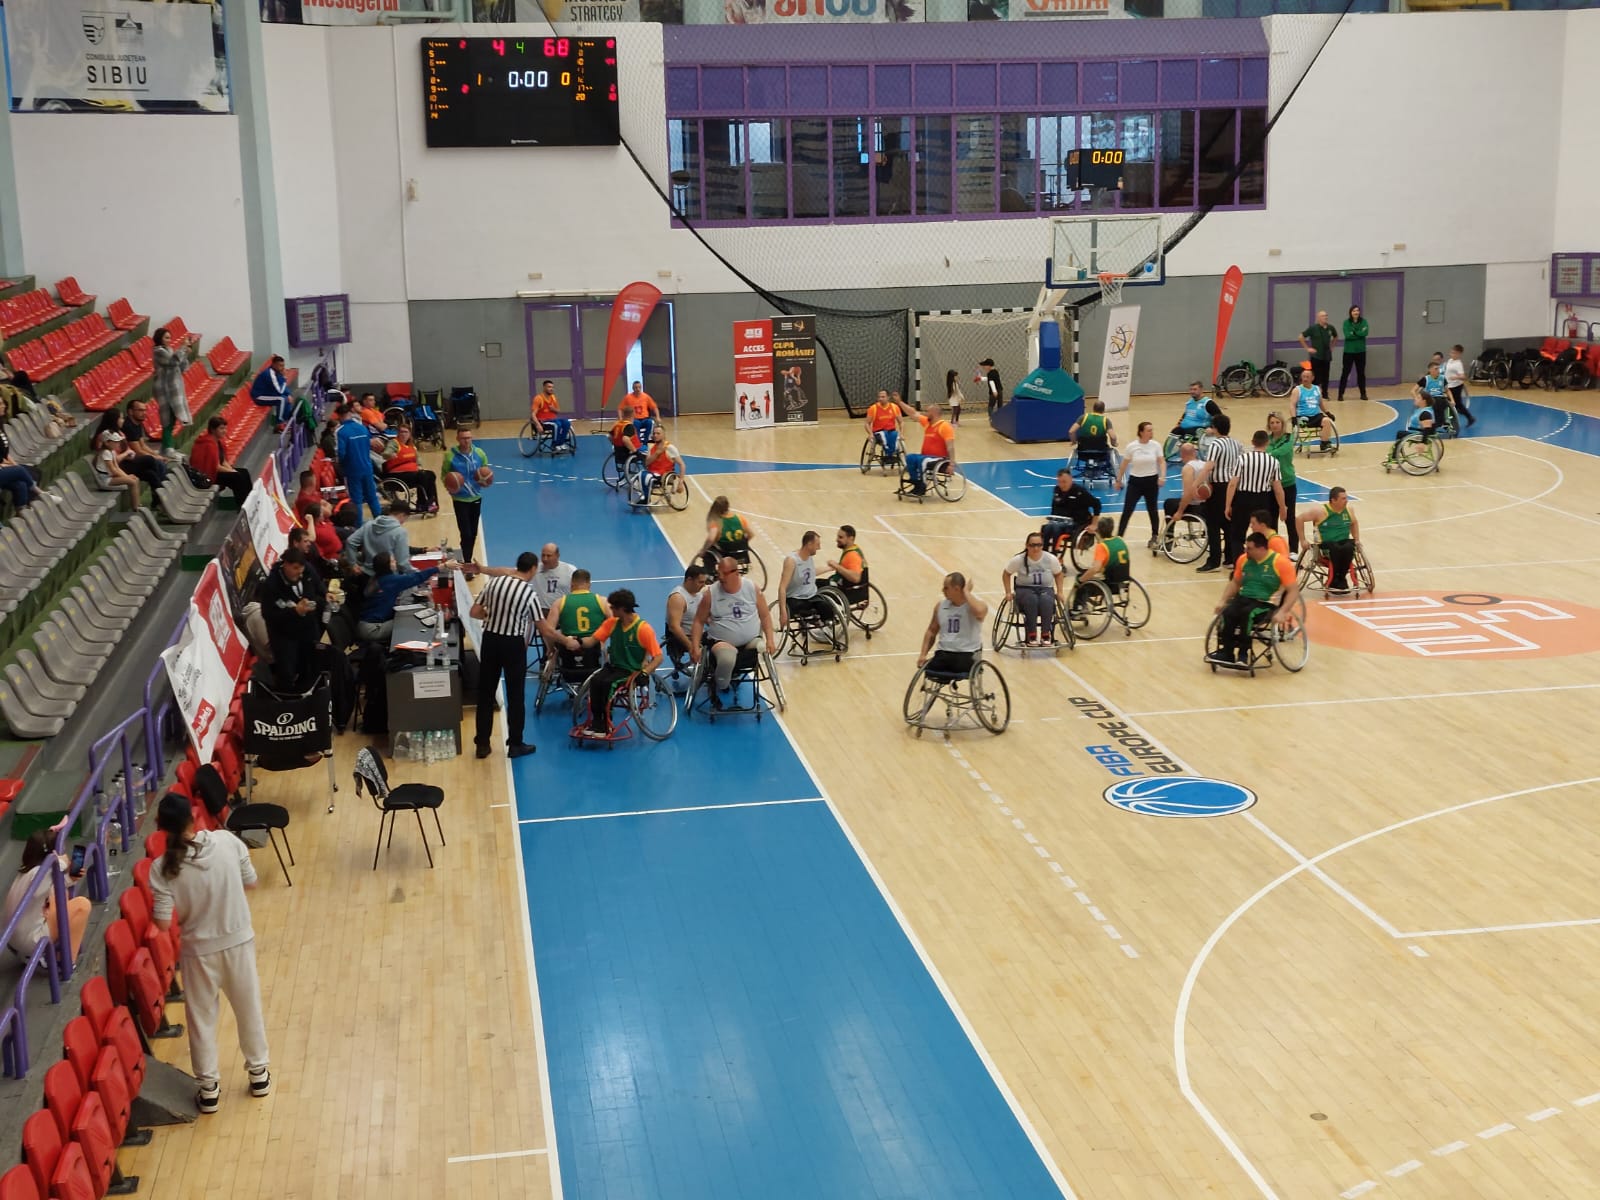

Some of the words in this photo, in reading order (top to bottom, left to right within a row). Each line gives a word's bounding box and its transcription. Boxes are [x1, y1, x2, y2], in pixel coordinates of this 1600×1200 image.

[571, 6, 623, 21] STRATEGY
[493, 39, 505, 56] 4
[516, 42, 524, 54] 4
[544, 38, 569, 56] 68
[87, 65, 146, 85] SIBIU
[561, 72, 570, 86] 0
[1092, 151, 1123, 164] 0:00
[743, 345, 766, 353] ACCES
[546, 580, 558, 593] 17
[1032, 573, 1043, 586] 11
[576, 606, 591, 632] 6
[947, 618, 961, 634] 10
[1067, 696, 1115, 719] CUP
[253, 716, 318, 737] SPALDING
[1097, 721, 1183, 774] EUROPE
[1085, 745, 1145, 777] FIBA
